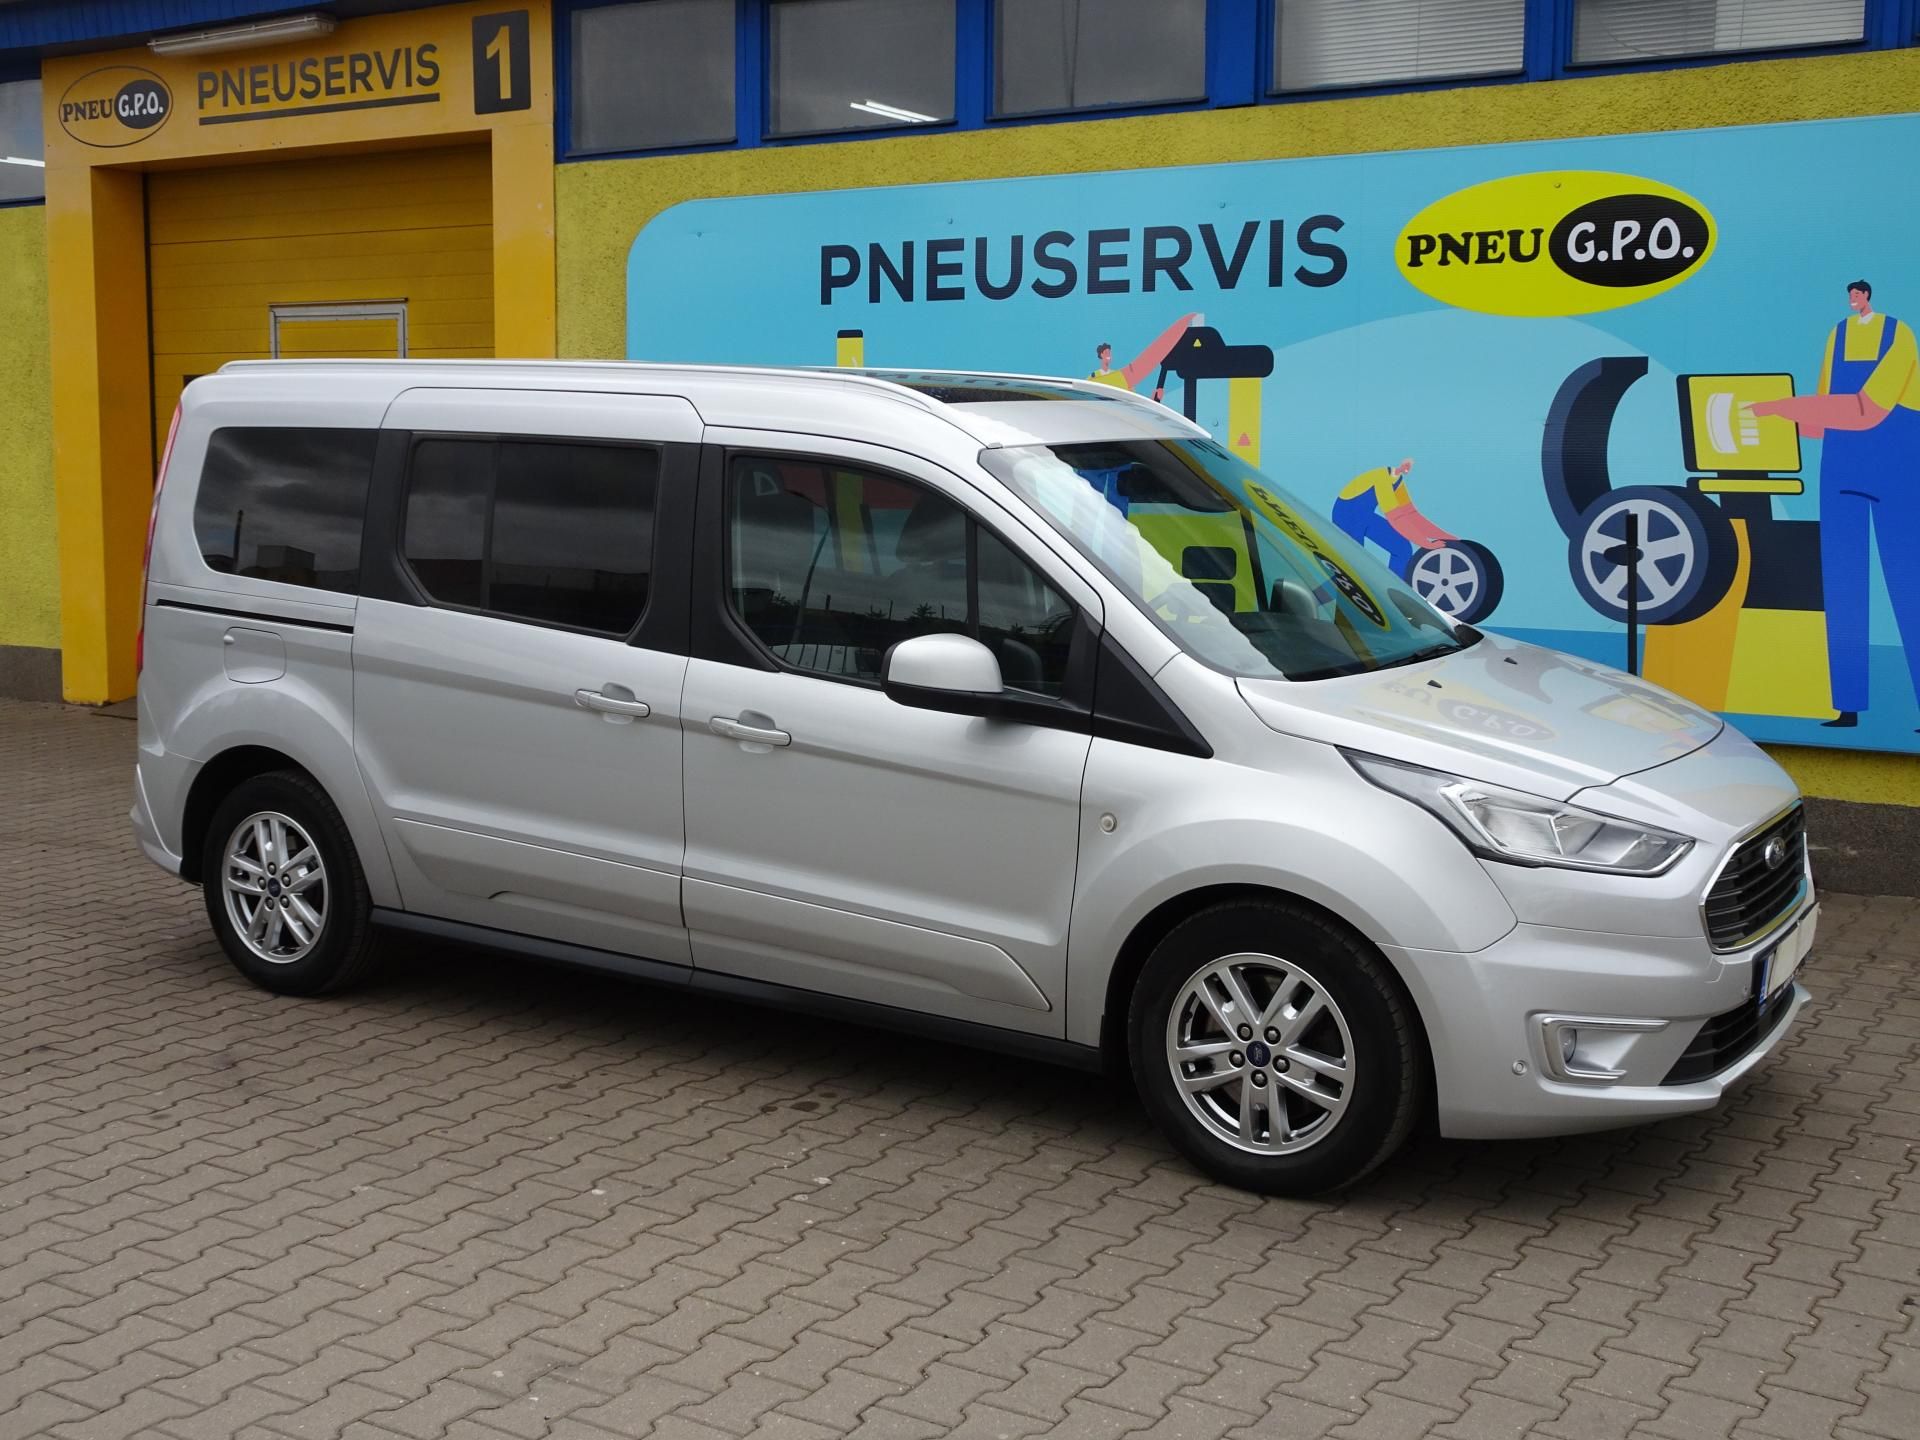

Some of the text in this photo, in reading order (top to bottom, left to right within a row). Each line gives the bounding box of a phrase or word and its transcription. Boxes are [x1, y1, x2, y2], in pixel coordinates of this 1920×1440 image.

[198, 43, 440, 109] PNEUSERVIS
[486, 25, 511, 99] 1
[62, 92, 164, 123] PNEU G.P.O.
[821, 214, 1349, 304] PNEUSERVIS
[1407, 217, 1695, 268] PNEU G.P.O.
